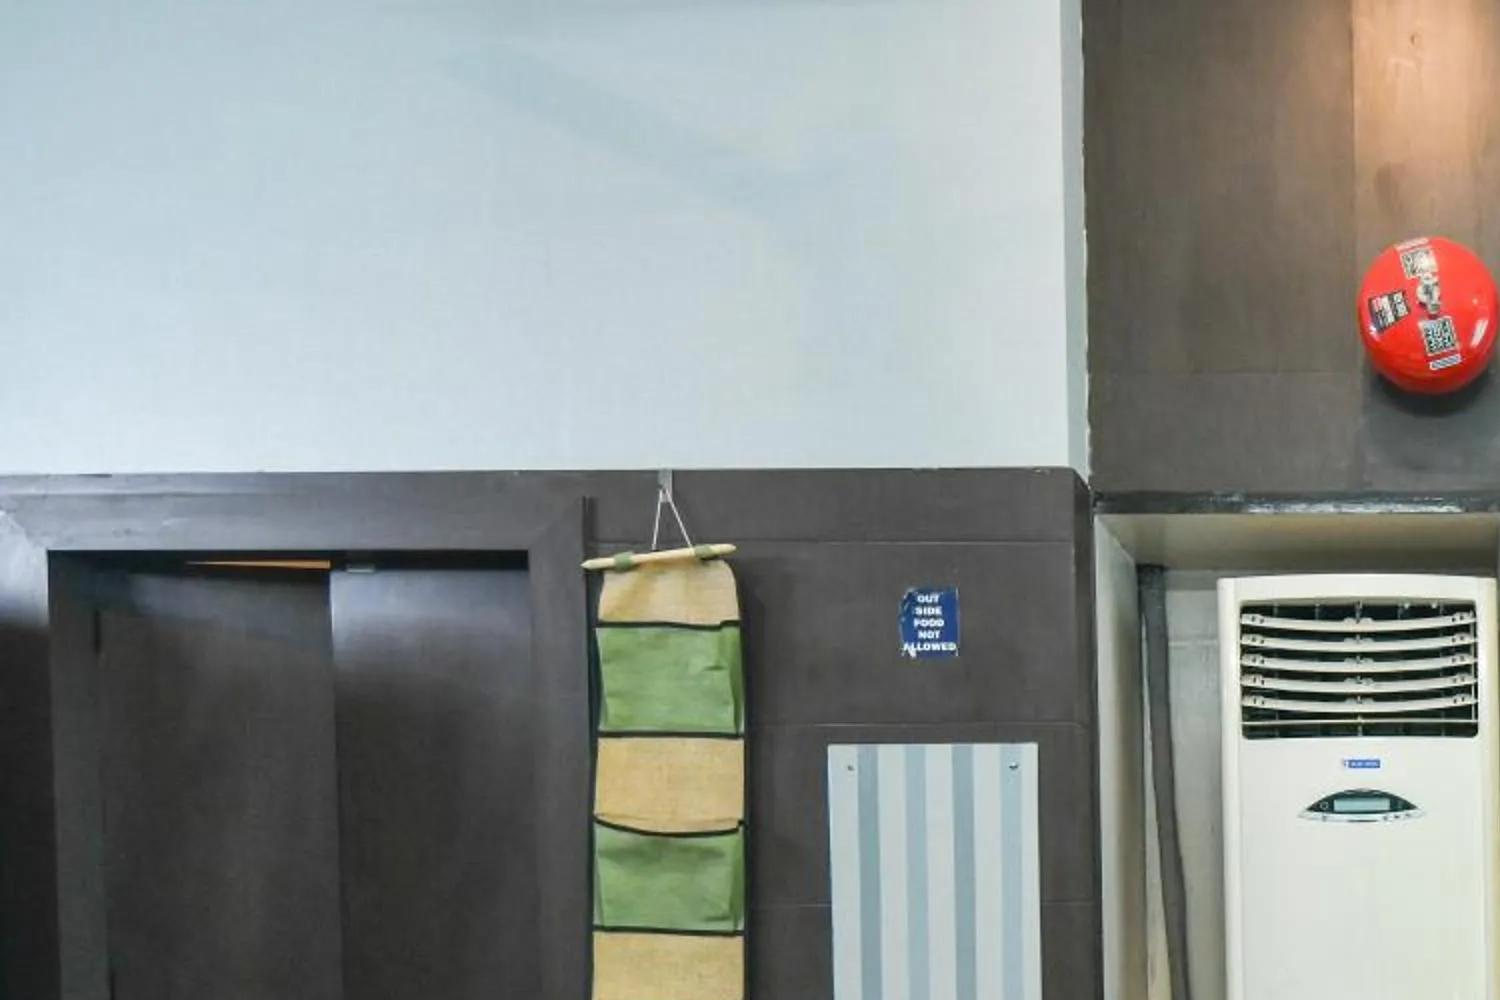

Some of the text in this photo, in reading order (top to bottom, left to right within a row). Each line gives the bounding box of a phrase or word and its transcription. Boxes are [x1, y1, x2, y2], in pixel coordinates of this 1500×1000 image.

[917, 594, 940, 603] OUT
[915, 606, 942, 615] SIDE
[913, 618, 945, 627] FOOD
[918, 630, 940, 639] NOT
[903, 641, 956, 652] ALLOWED
